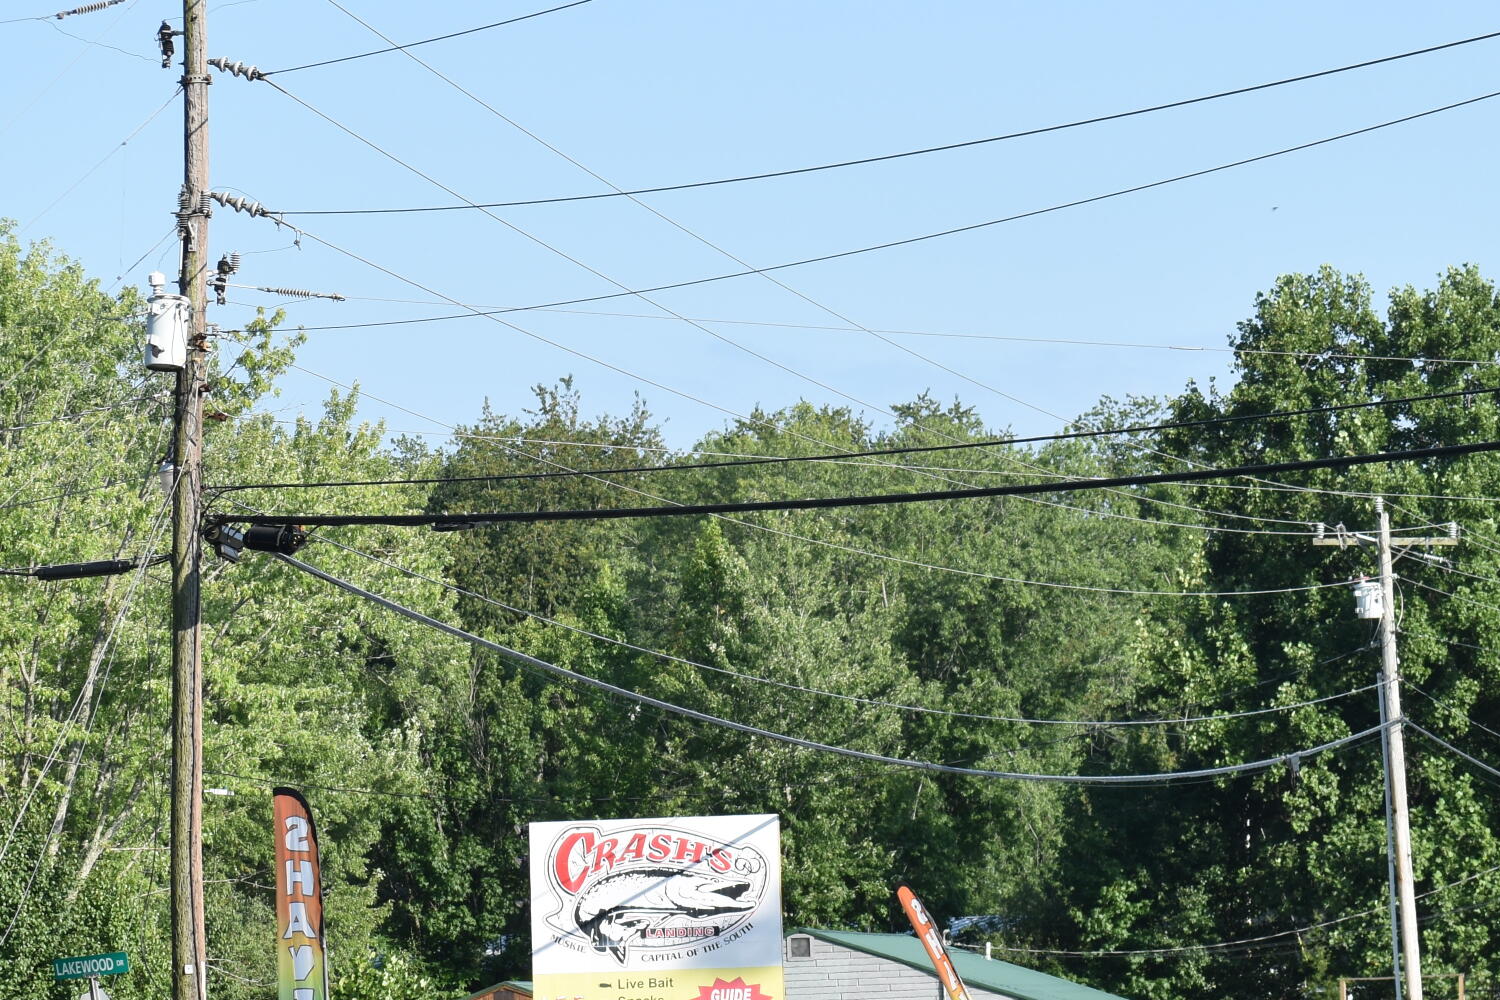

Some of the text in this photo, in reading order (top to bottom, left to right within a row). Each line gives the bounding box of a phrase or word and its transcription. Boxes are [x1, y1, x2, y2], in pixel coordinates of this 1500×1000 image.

[554, 831, 733, 894] CRASH'S
[645, 926, 715, 939] LANDING
[550, 922, 755, 963] MUSKIE CAPITAL OF THE SOUTH
[55, 957, 115, 976] LAKEWOOD
[617, 977, 674, 990] Live Bait
